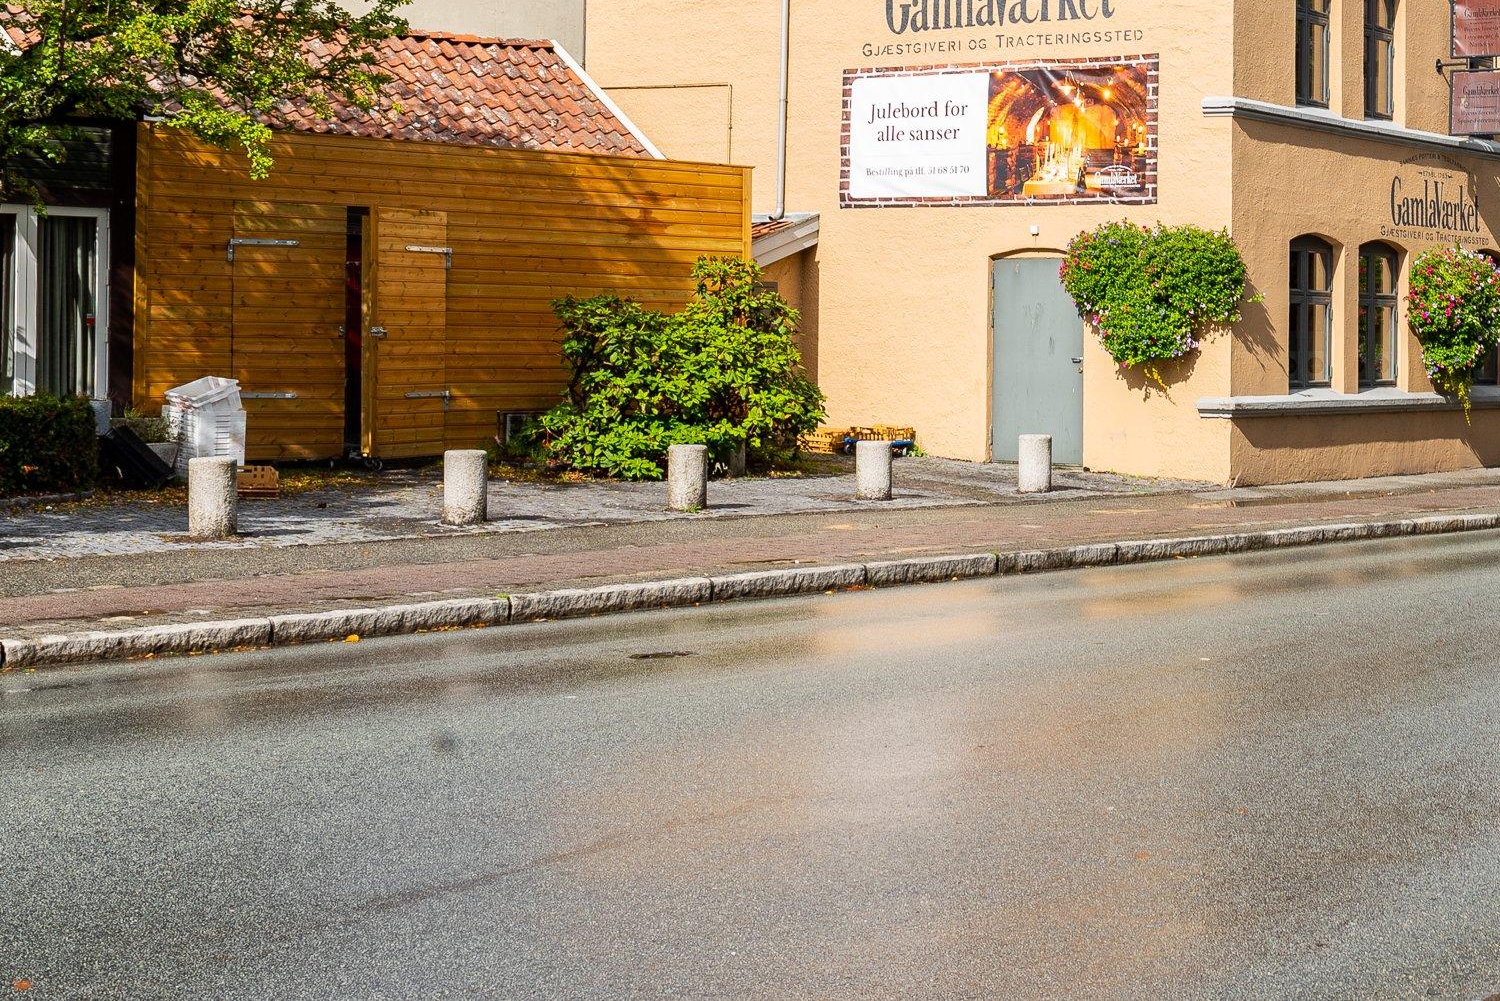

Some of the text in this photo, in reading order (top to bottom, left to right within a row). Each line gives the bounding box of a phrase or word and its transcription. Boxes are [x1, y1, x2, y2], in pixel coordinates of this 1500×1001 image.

[862, 29, 1143, 57] GJÆSTGIVERI OG TRACTERINGSSTED
[868, 100, 968, 124] Julebord for
[877, 125, 960, 142] alle sanser
[1390, 175, 1480, 233] GamlaVærket
[1380, 225, 1424, 238] GJÆSTGIVERI
[1425, 232, 1434, 241] OG
